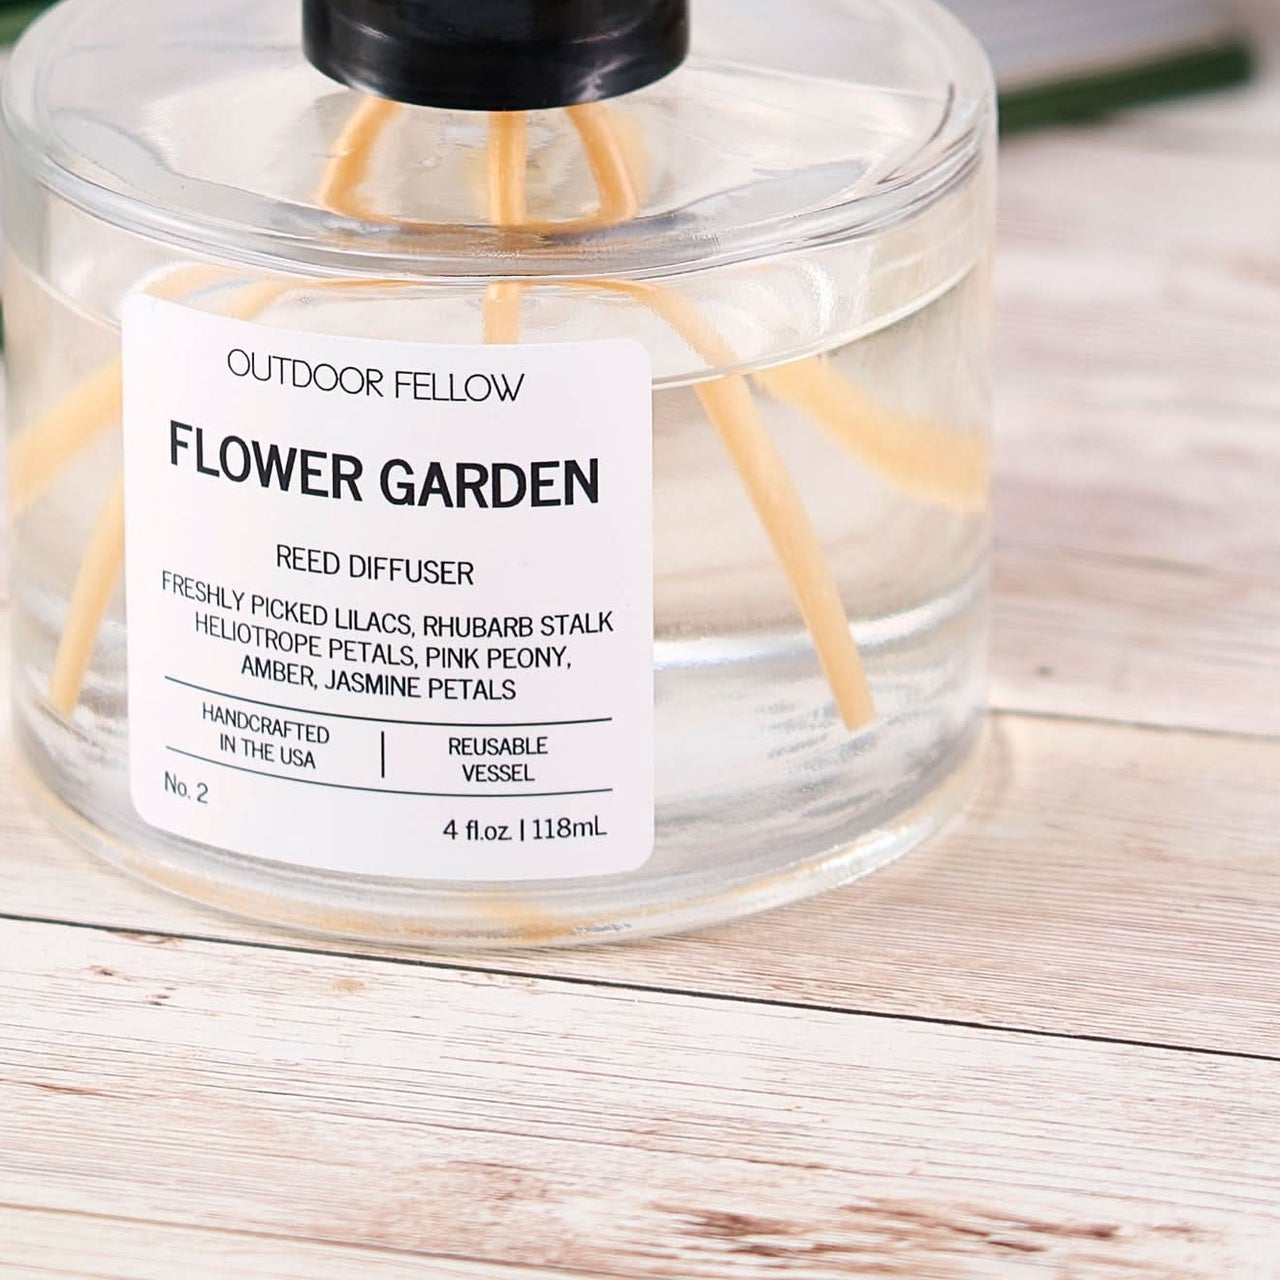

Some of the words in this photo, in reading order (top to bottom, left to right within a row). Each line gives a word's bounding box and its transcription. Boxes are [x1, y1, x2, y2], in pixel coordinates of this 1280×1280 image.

[227, 348, 385, 398] OUTDOOR
[395, 370, 526, 402] FELLOW
[170, 419, 364, 502] FLOWER
[379, 457, 600, 509] GARDEN
[276, 543, 341, 575] REED
[349, 553, 475, 586] DIFFUSER
[162, 570, 246, 612] FRESHLY
[251, 594, 329, 627] PICKED
[335, 607, 416, 639] LILACS,
[423, 615, 535, 639] RHUBARB
[540, 610, 615, 638] STALK
[195, 611, 323, 658] HELIOTROPE
[328, 637, 419, 670] PETALS,
[425, 646, 481, 670] PINK
[487, 645, 573, 670] PEONY,
[240, 654, 319, 692] AMBER,
[324, 669, 422, 699] JASMINE
[428, 677, 518, 701] PETALS
[202, 702, 331, 745] HANDCRAFTED
[220, 733, 237, 754] IN
[240, 737, 276, 764] THE
[279, 745, 317, 770] USA
[448, 735, 550, 757] REUSABLE
[164, 771, 191, 799] No.
[196, 781, 210, 804] 2
[461, 763, 537, 783] VESSEL
[442, 818, 460, 841] 4
[465, 818, 514, 842] fl.oz.
[532, 816, 608, 841] 118mL
